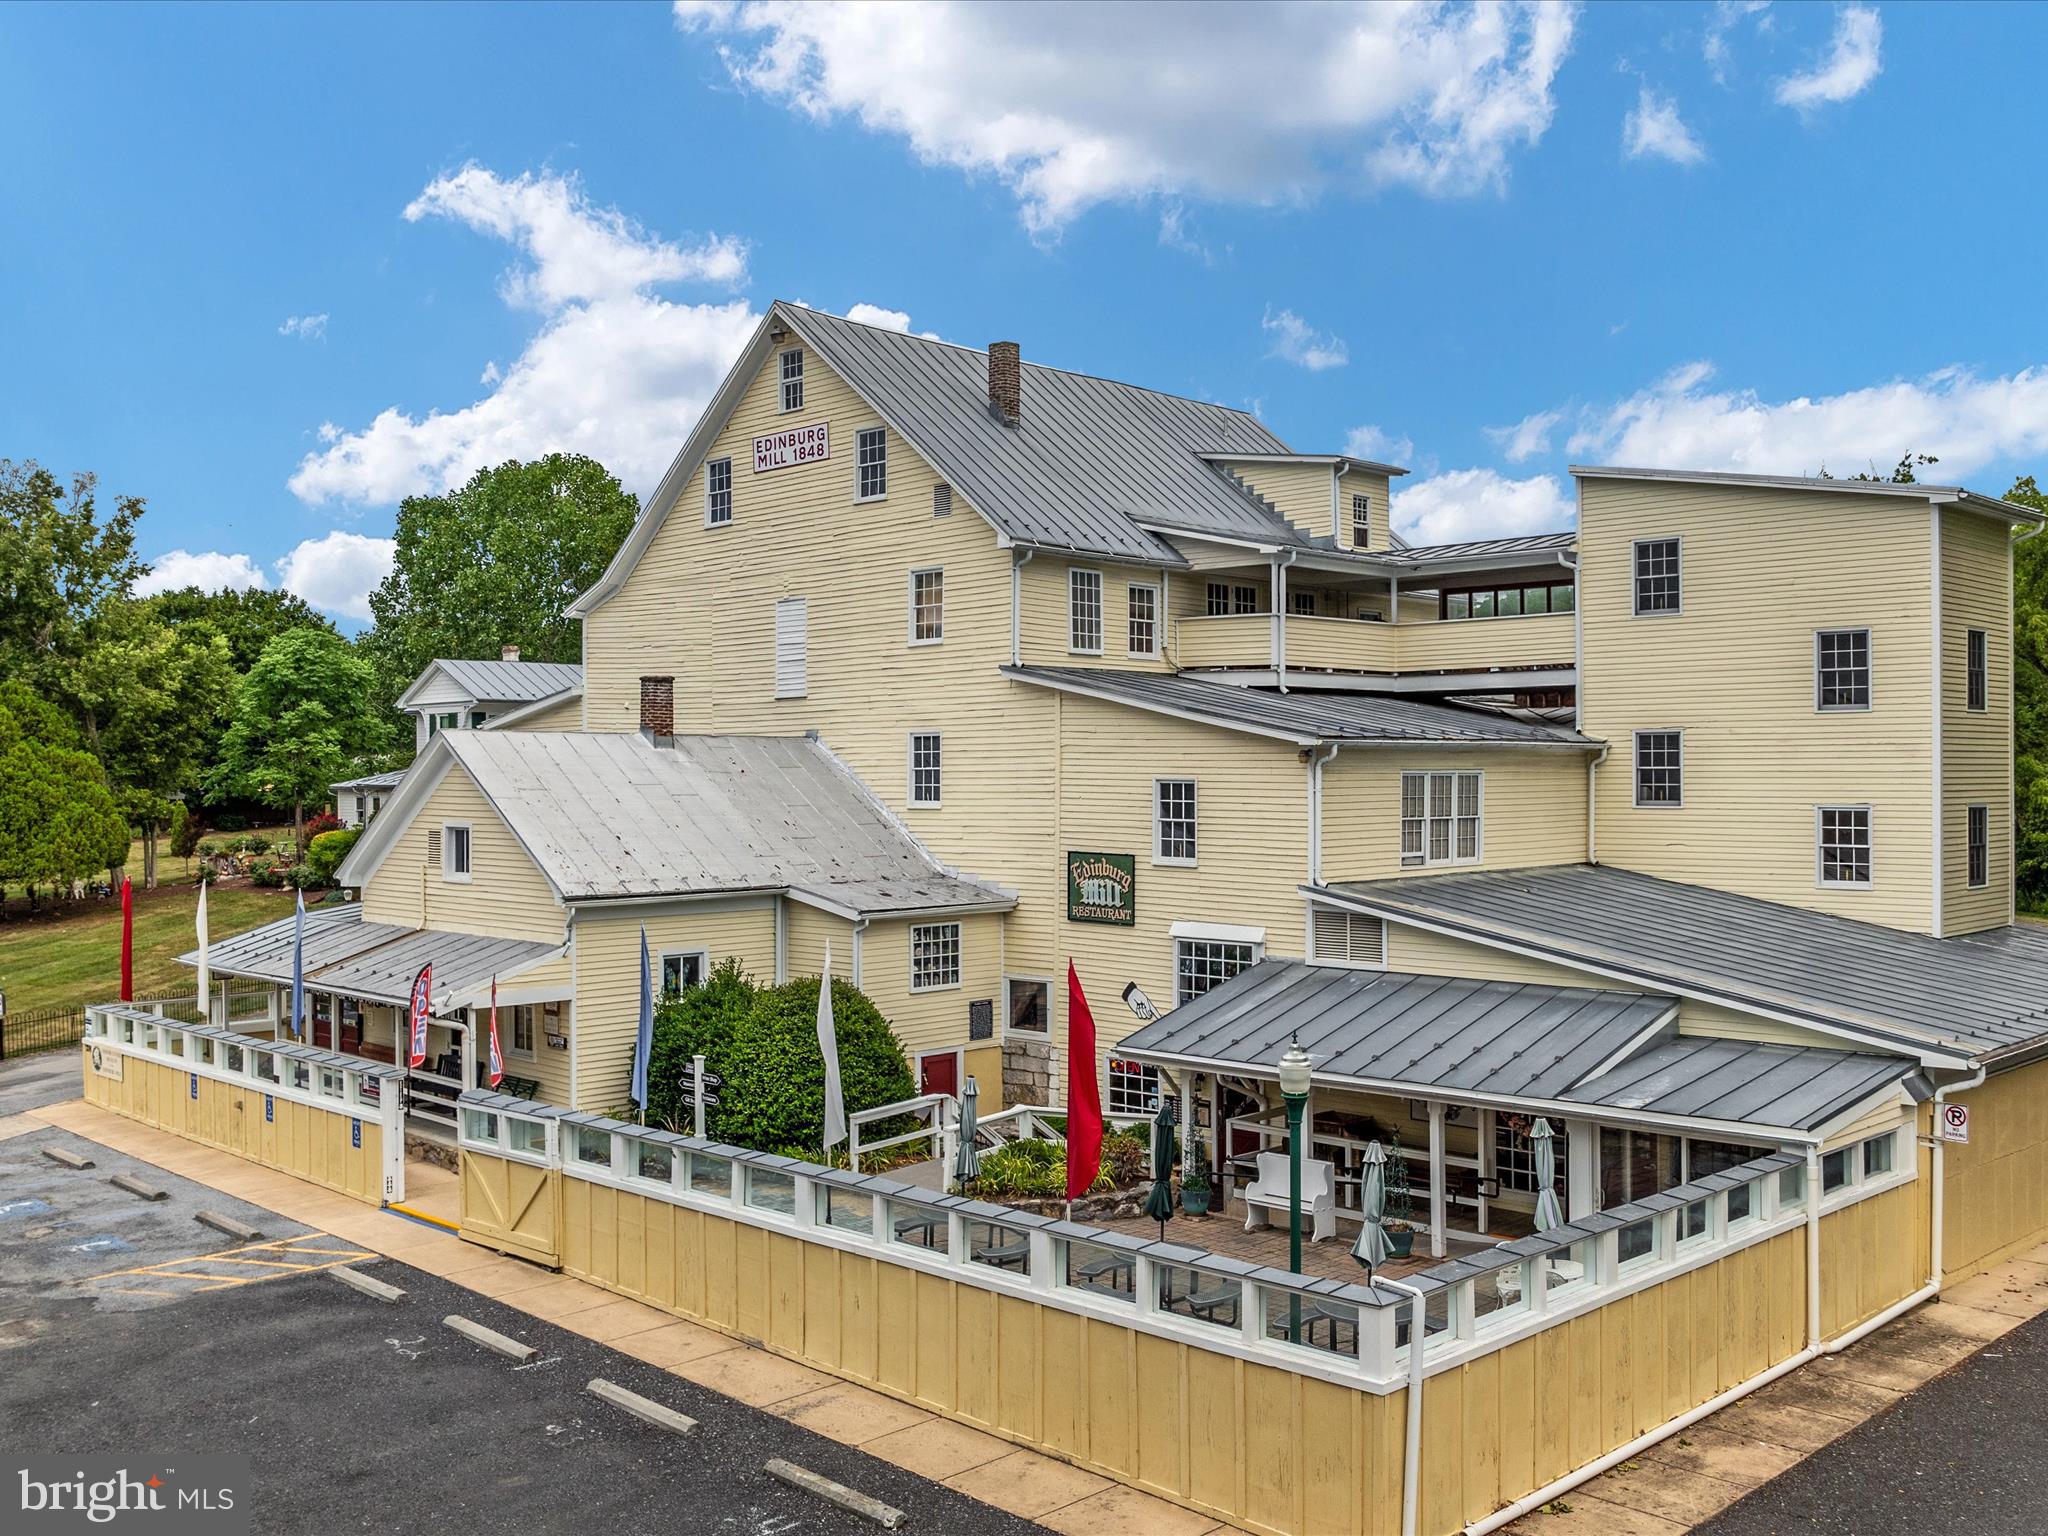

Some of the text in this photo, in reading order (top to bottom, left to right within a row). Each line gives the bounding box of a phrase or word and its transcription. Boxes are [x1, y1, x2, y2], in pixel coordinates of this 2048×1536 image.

[756, 427, 826, 454] EDINBURG
[758, 443, 825, 468] MILL 1848
[1070, 857, 1132, 893] Edinburg
[1072, 905, 1132, 920] RESTAURANT
[413, 977, 428, 1056] OPEN
[1946, 1131, 1966, 1139] PARKING
